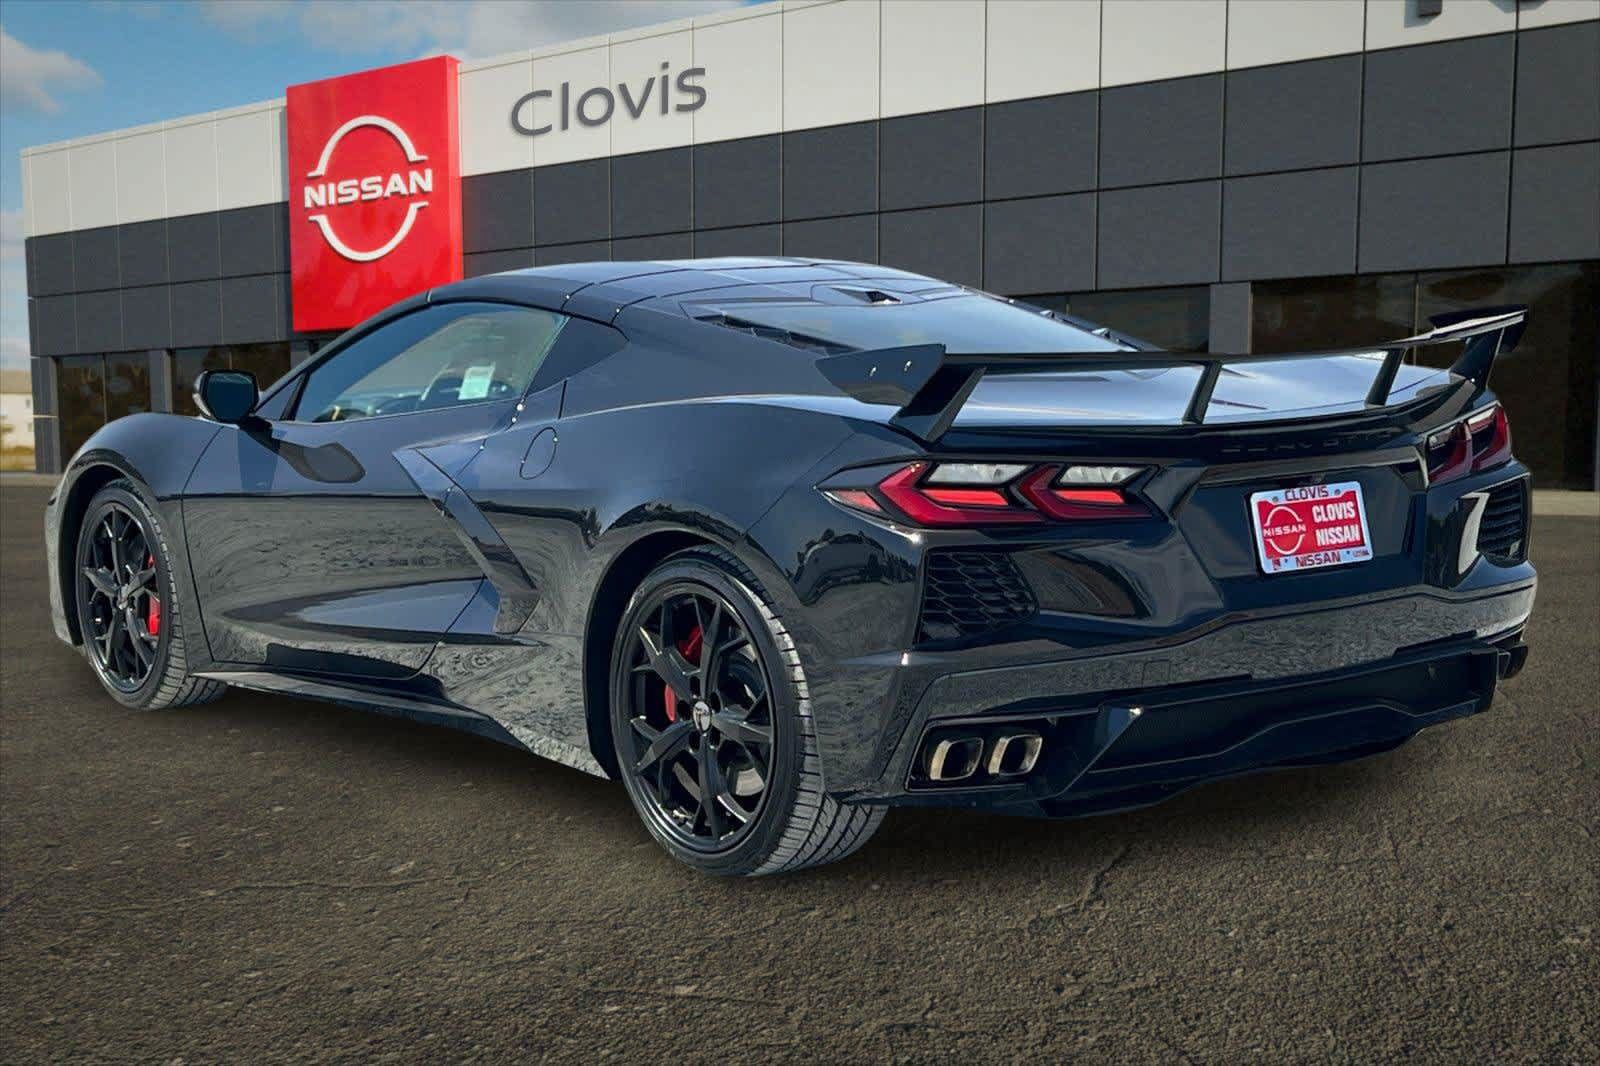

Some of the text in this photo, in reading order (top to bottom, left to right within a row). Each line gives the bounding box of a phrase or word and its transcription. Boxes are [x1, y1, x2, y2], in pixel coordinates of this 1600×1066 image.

[510, 61, 708, 137] Clovis
[303, 167, 433, 209] NISSAN
[1284, 485, 1329, 501] CLOVIS
[1312, 501, 1356, 523] CLOVIS
[1263, 524, 1306, 536] NISSAN
[1315, 525, 1360, 546] NISSAN
[1295, 551, 1342, 568] NISSAN
